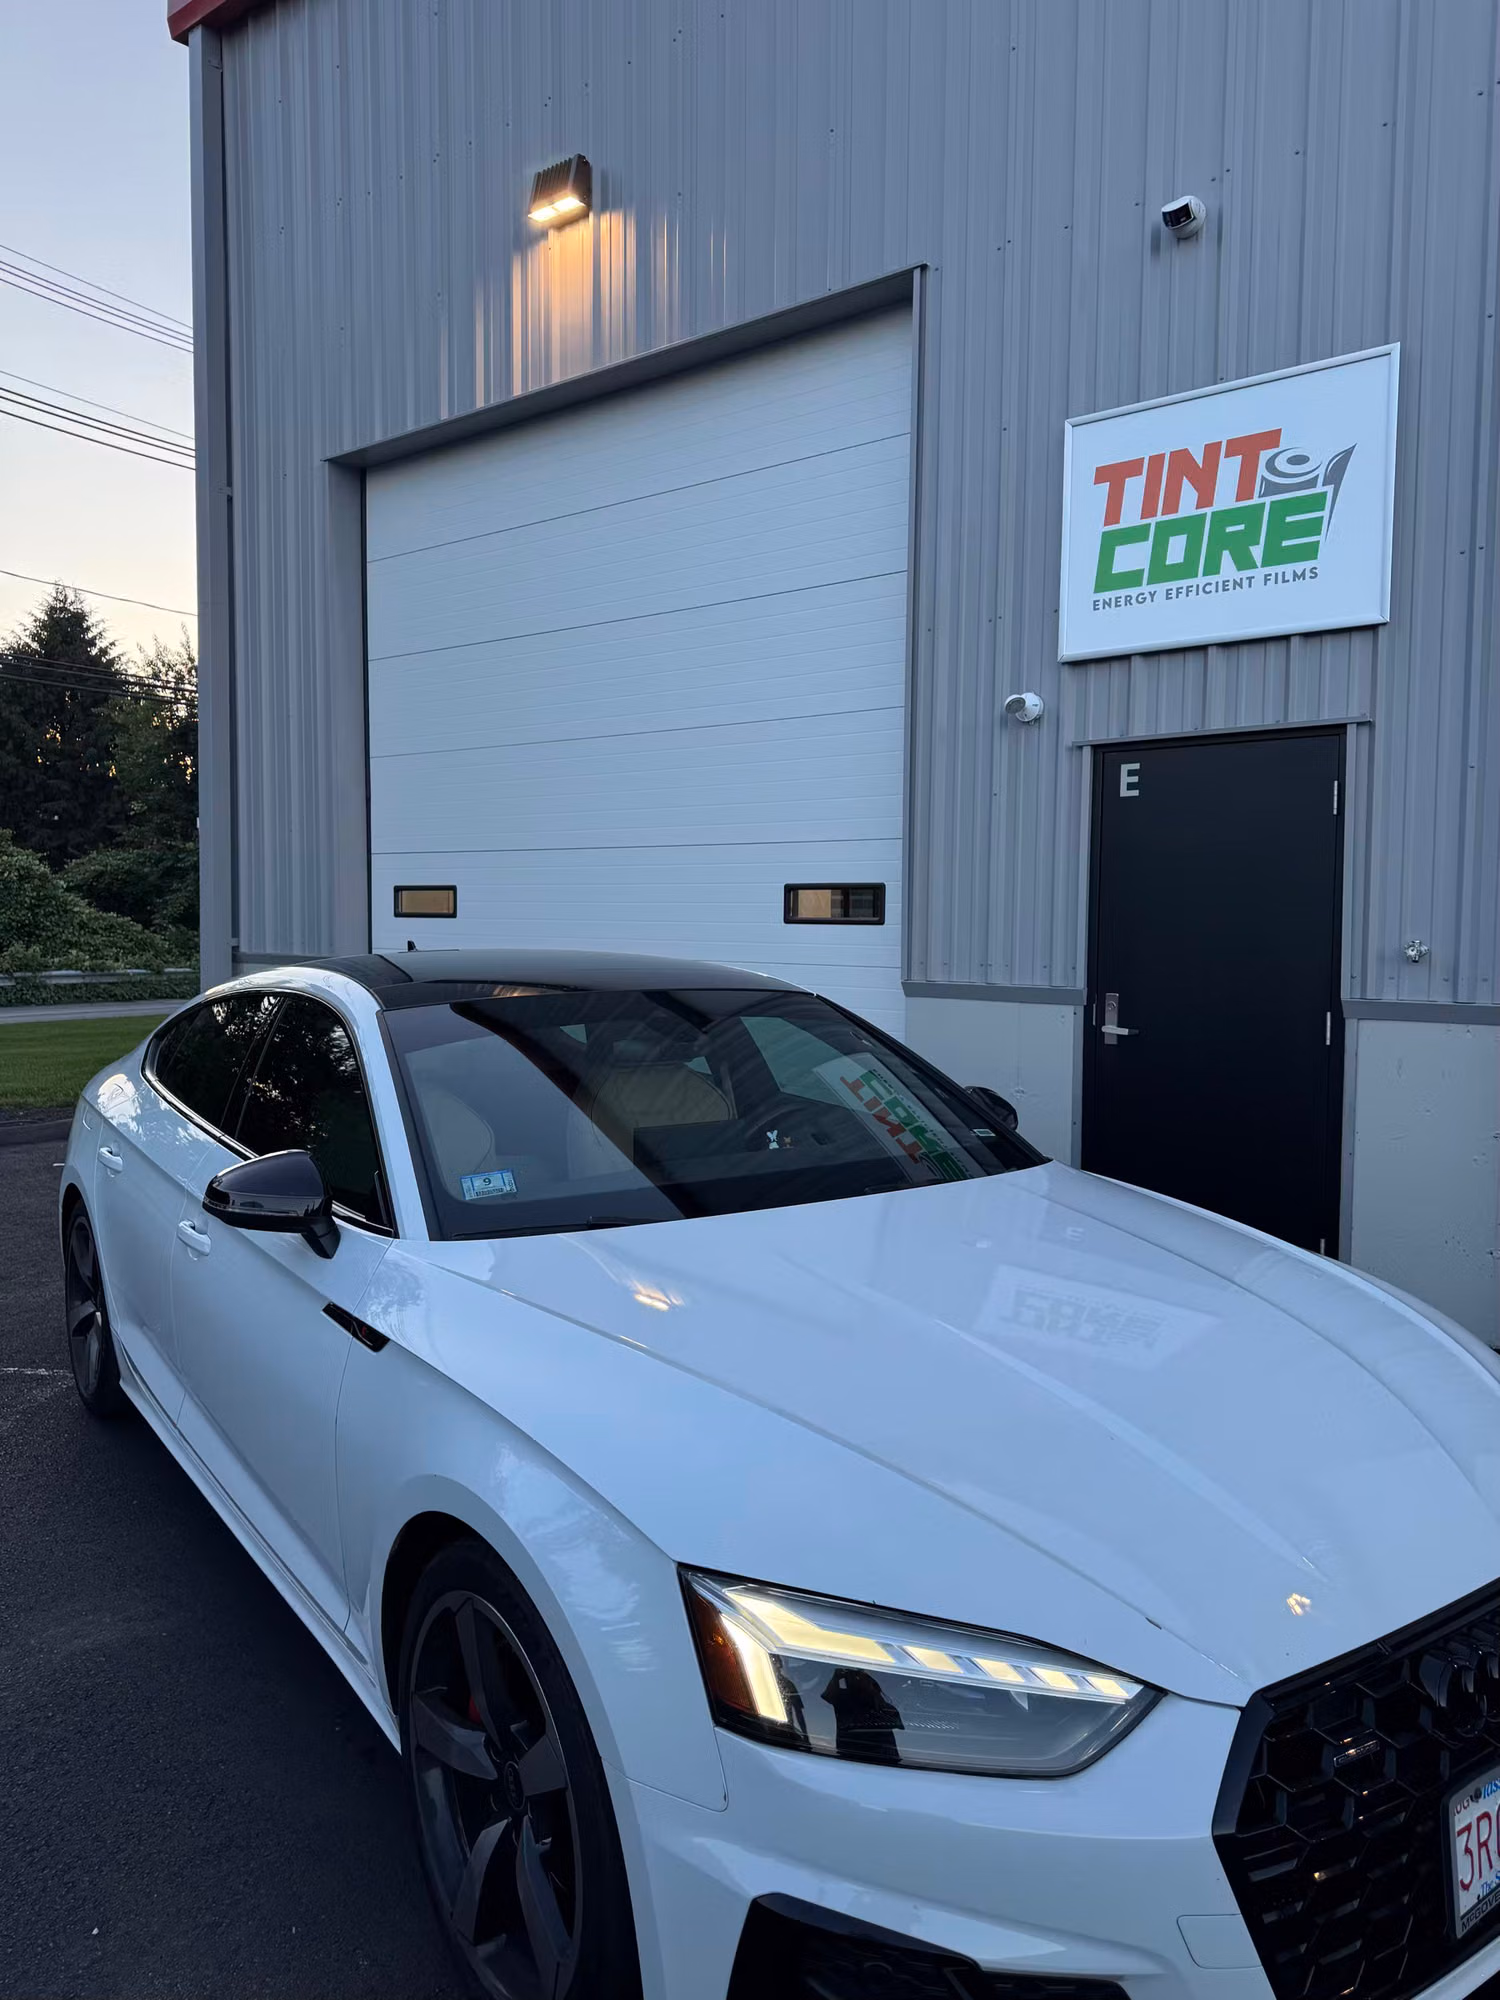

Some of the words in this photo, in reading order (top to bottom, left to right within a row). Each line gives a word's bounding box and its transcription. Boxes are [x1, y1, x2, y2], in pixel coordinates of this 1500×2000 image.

[1093, 427, 1283, 528] TINT
[1093, 490, 1328, 594] CORE
[1092, 590, 1157, 612] ENERGY
[1165, 575, 1255, 601] EFFICIENT
[1263, 566, 1319, 587] FILMS
[1120, 763, 1140, 797] E
[483, 1177, 492, 1186] 9
